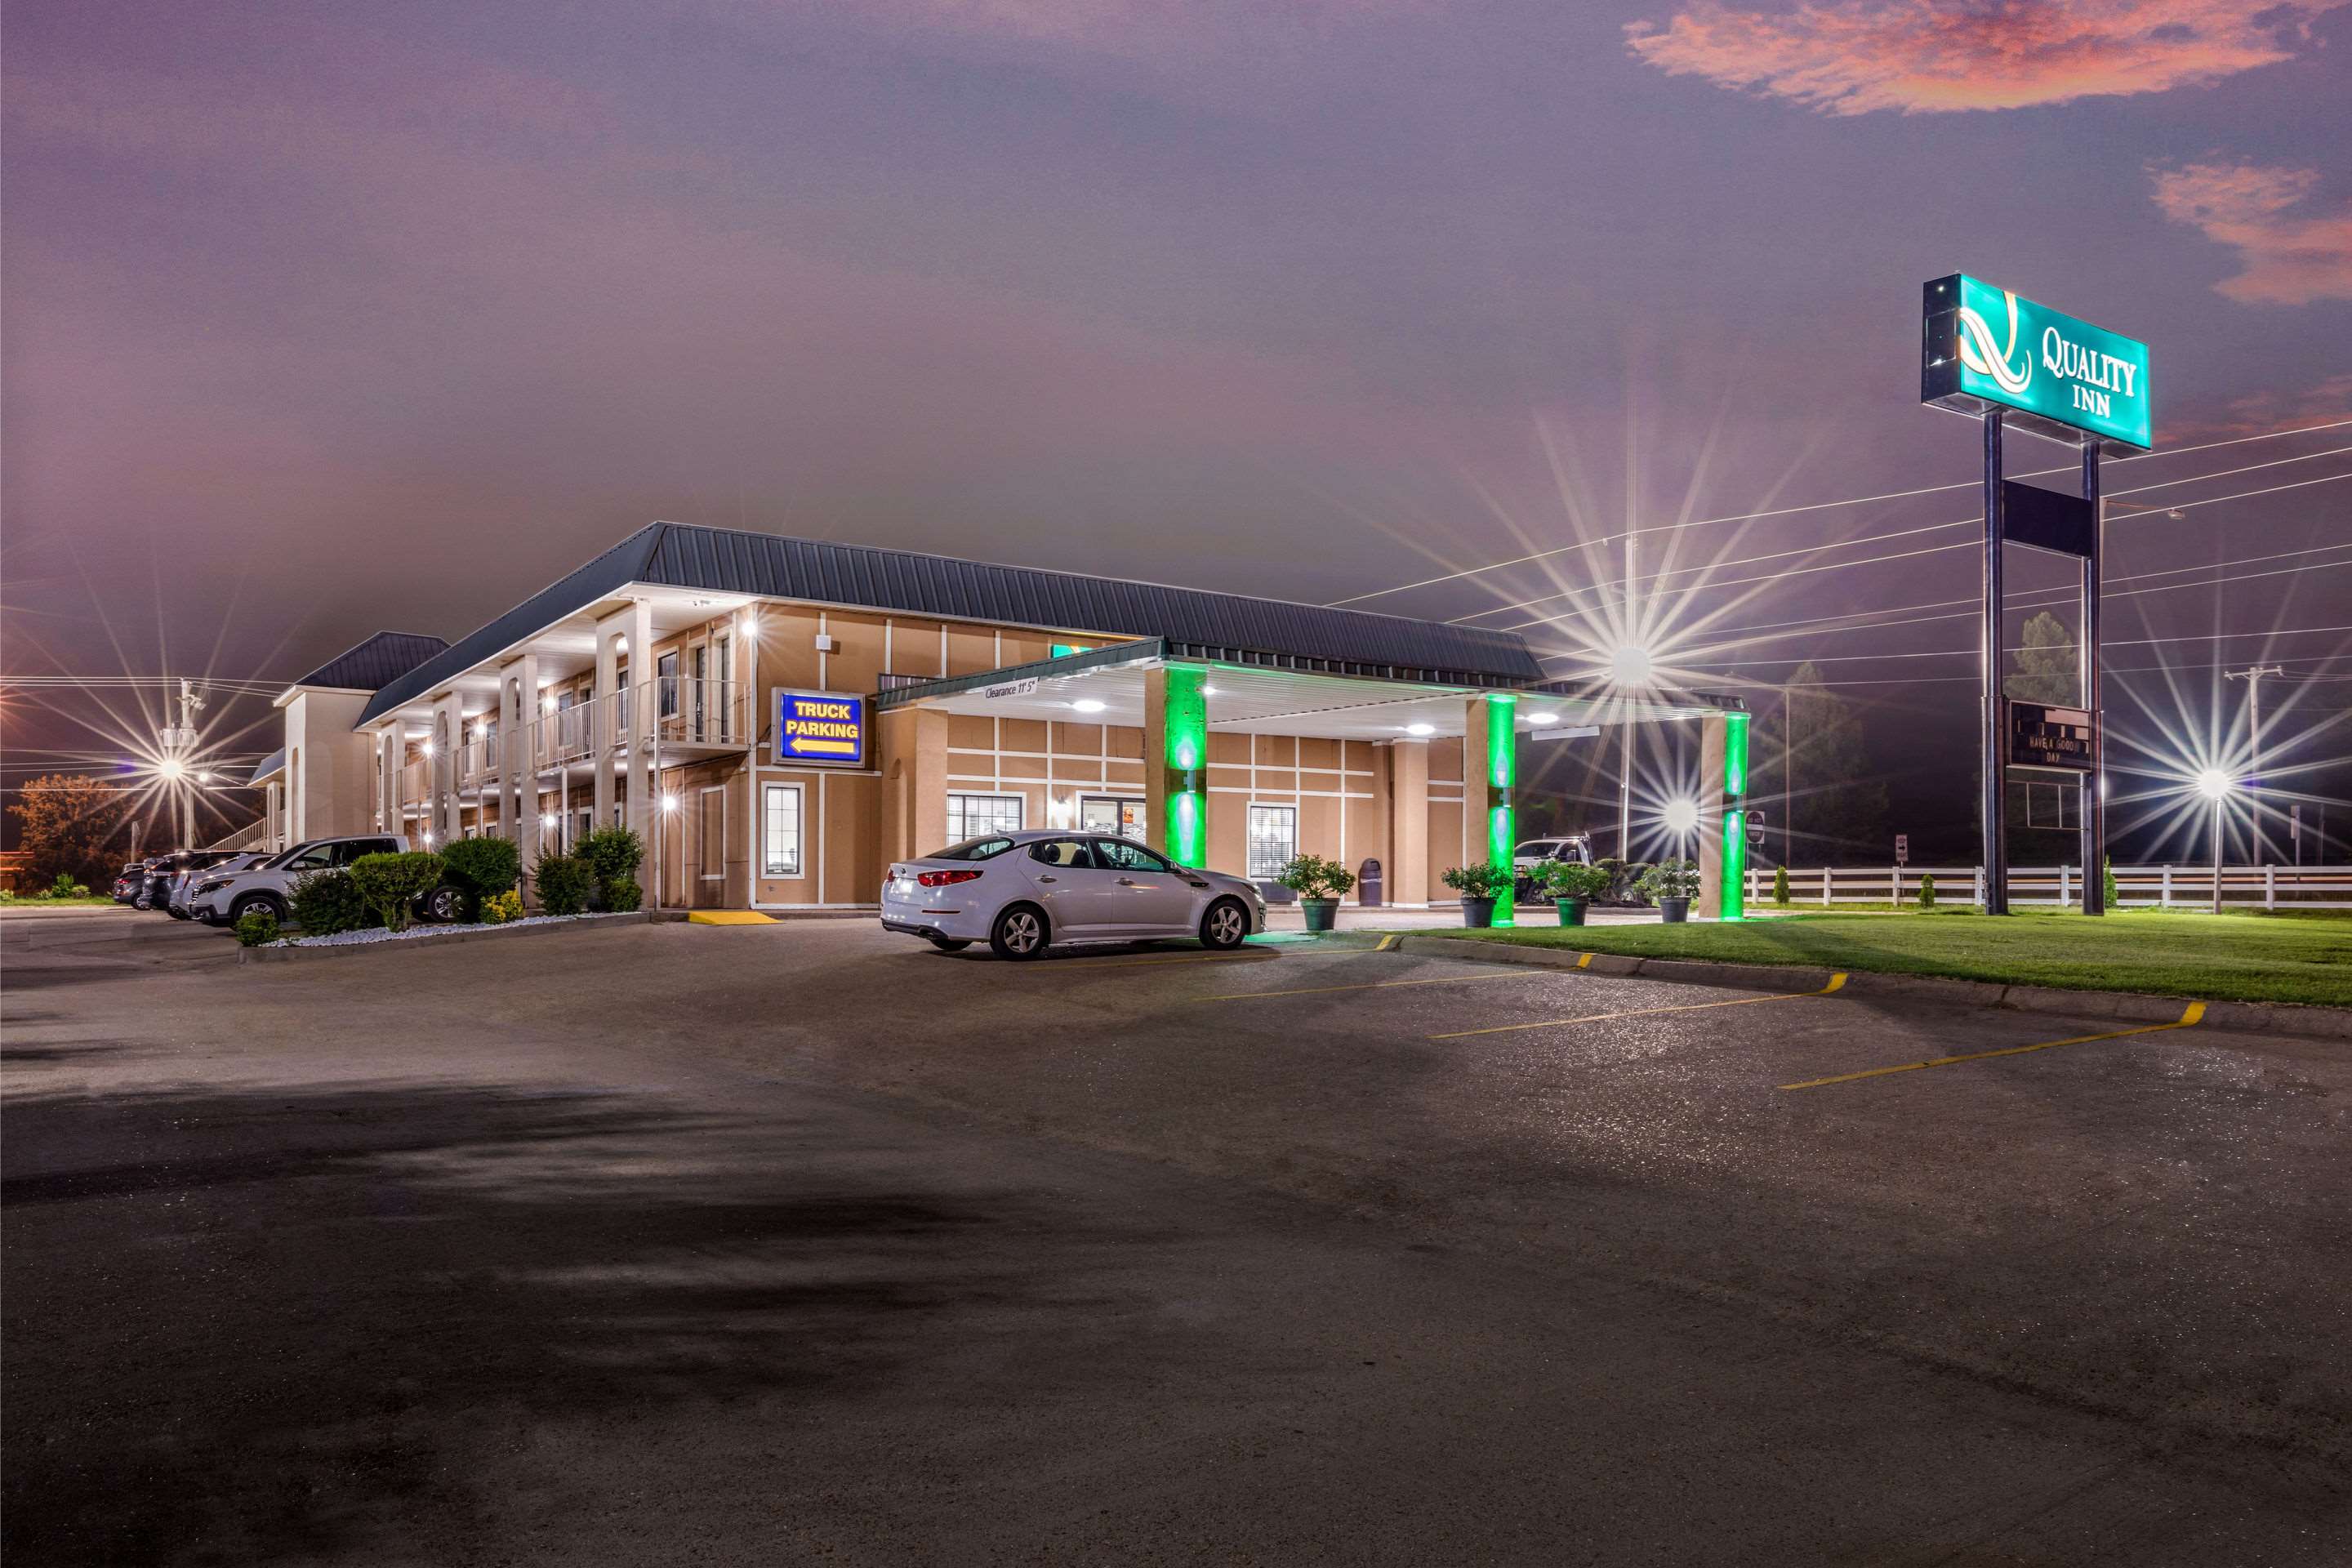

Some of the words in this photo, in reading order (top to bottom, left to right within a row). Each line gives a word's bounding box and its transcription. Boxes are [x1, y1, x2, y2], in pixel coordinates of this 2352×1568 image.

[2042, 327, 2136, 397] QUALITY
[2073, 385, 2110, 418] INN
[986, 687, 1016, 698] Clearance
[794, 702, 850, 719] TRUCK
[786, 719, 858, 738] PARKING
[2047, 752, 2060, 763] DAY
